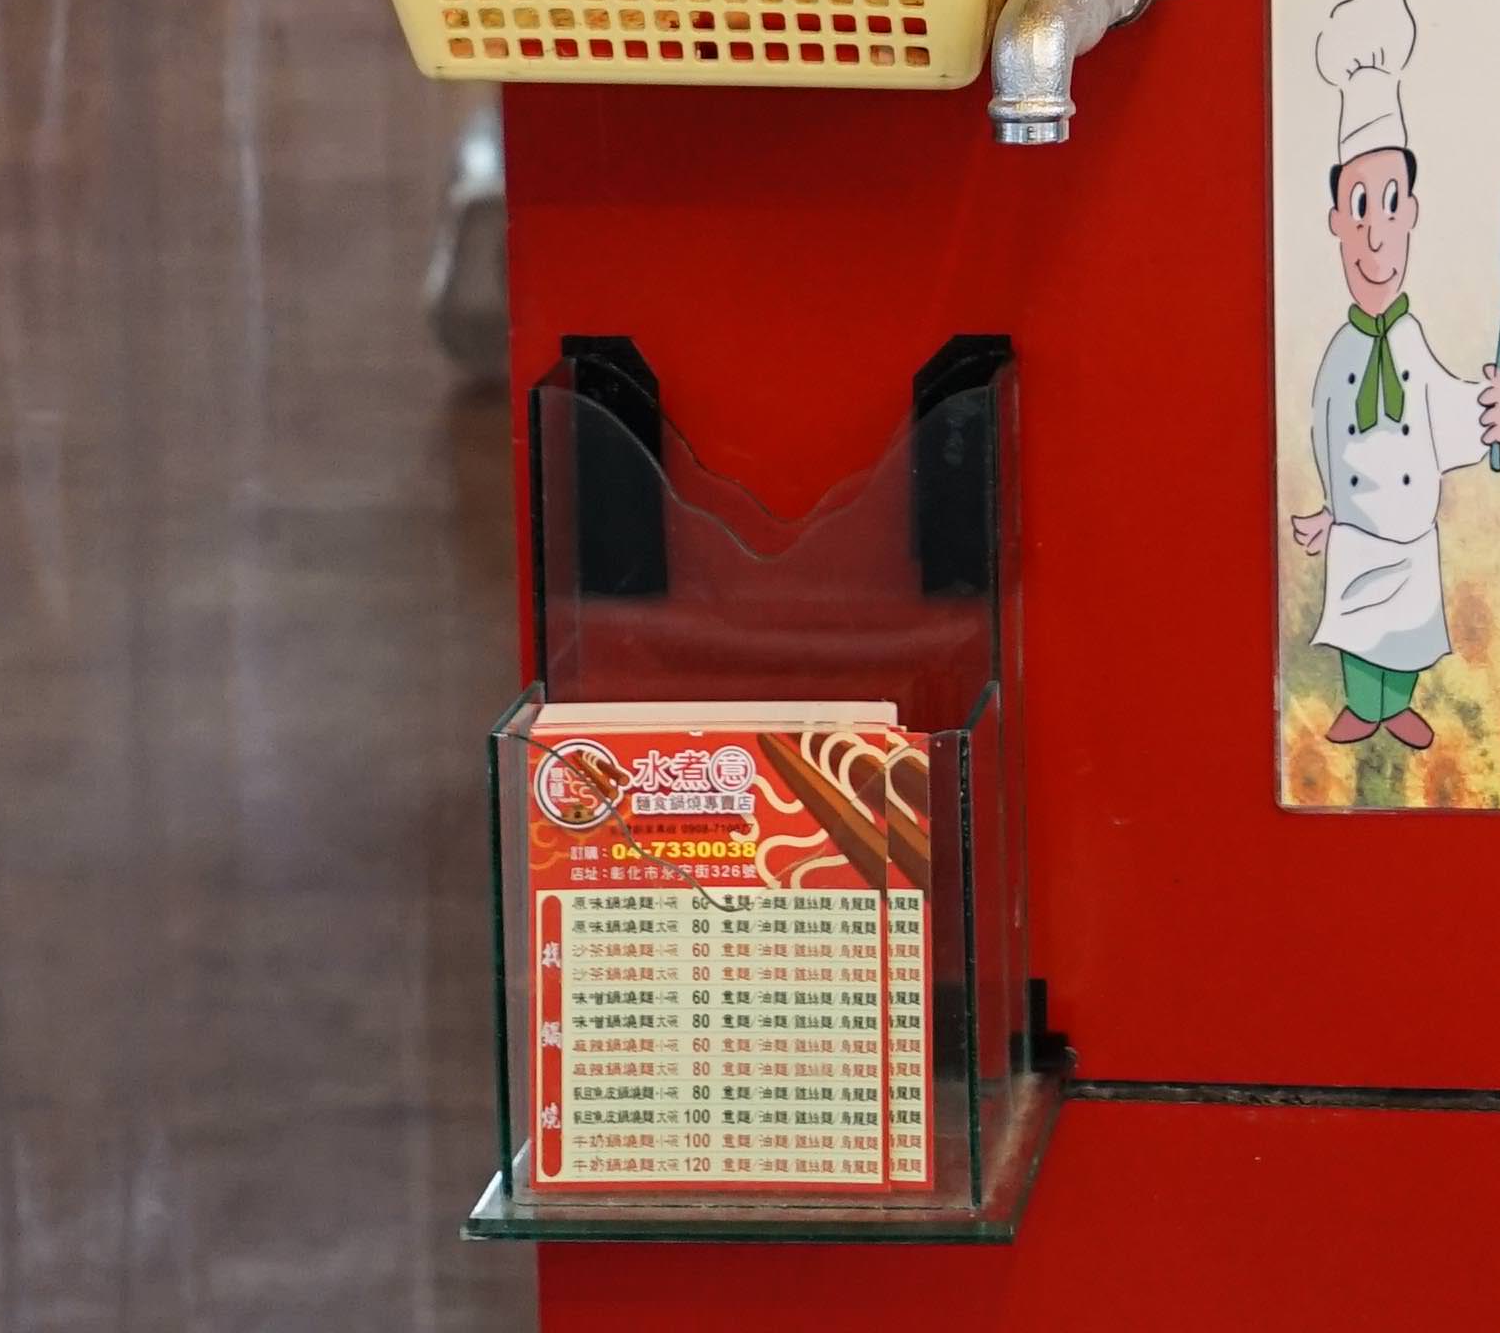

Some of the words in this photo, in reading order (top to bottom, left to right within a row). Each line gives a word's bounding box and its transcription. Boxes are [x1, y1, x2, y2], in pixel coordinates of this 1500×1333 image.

[631, 746, 756, 793] 水煮意
[611, 842, 757, 860] 04-7330038
[692, 920, 709, 933] 80
[692, 943, 709, 956] 60
[692, 1014, 710, 1028] 80
[684, 1109, 710, 1123] 100
[684, 1158, 710, 1172] 120
